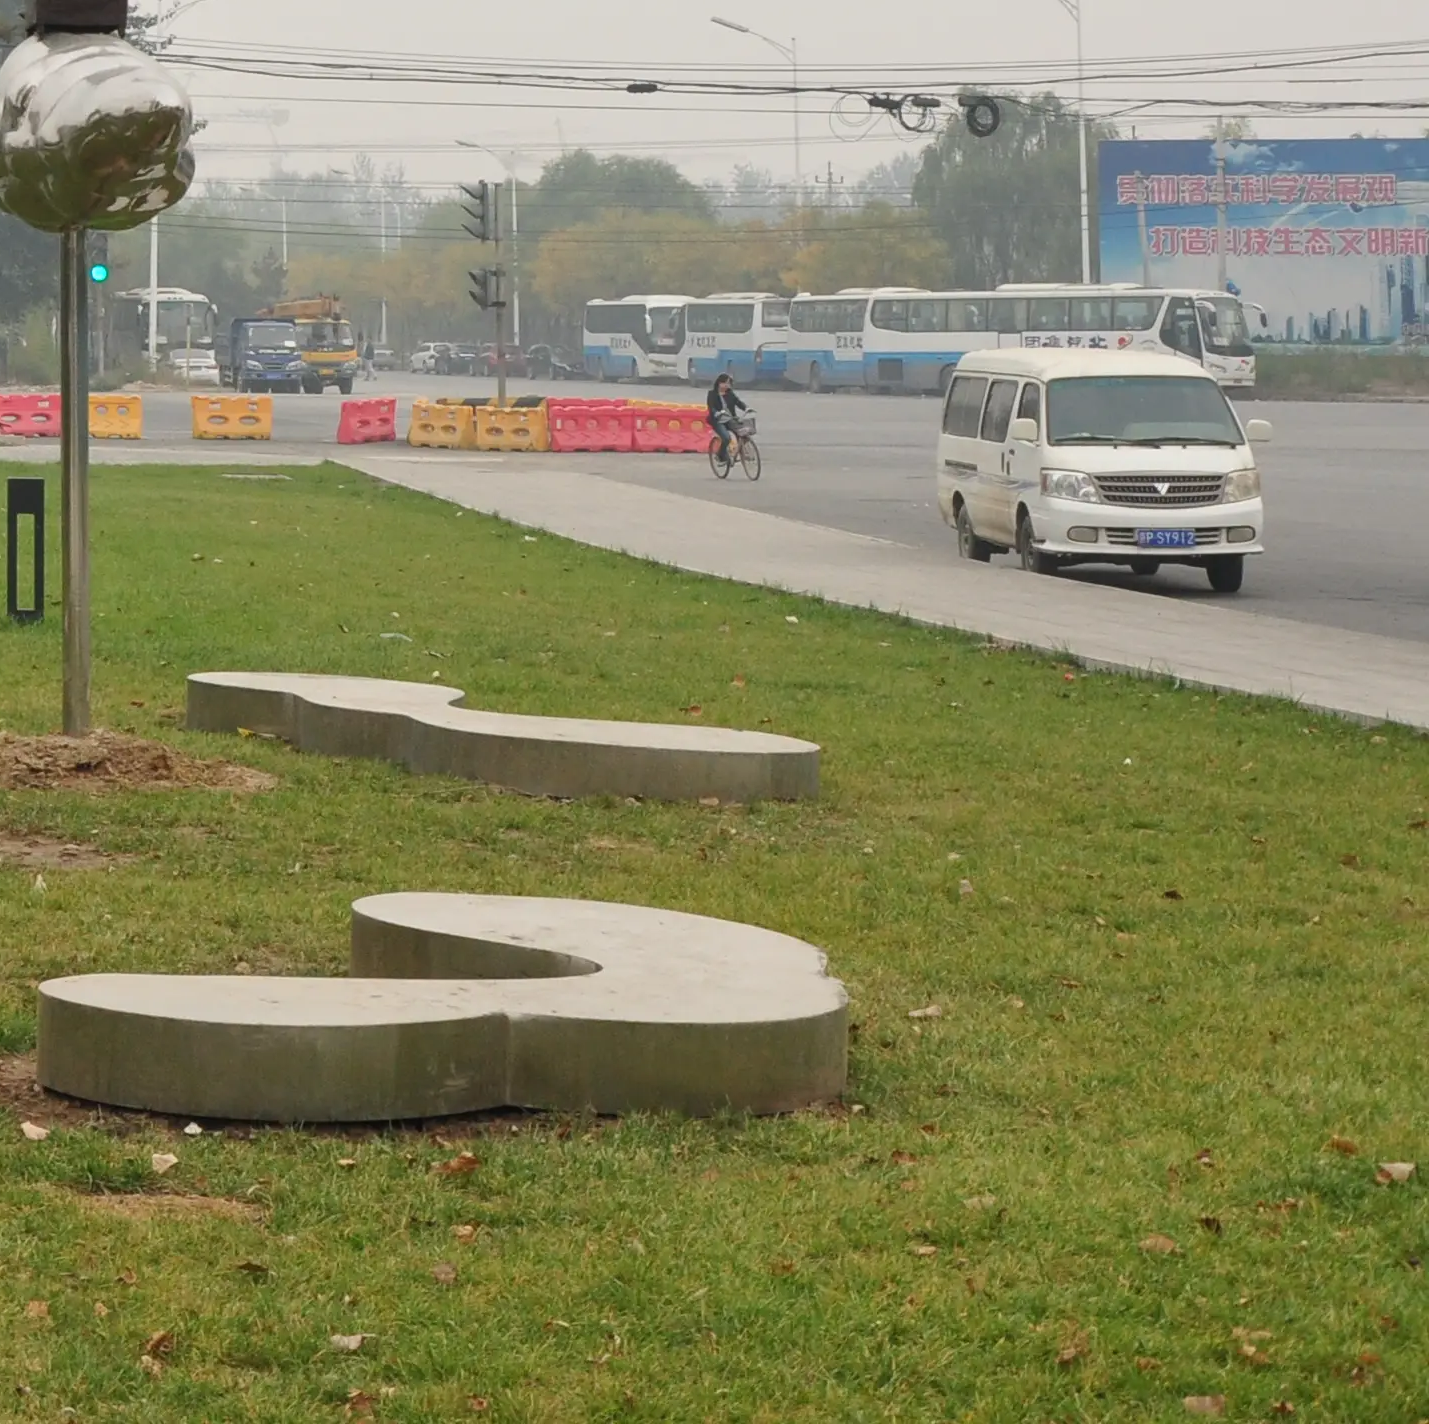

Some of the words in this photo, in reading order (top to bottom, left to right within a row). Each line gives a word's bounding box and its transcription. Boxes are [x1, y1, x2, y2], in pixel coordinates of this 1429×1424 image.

[1117, 174, 1396, 205] 贯彻落实科学发展观
[1149, 227, 1429, 257] 打造科技生态文明新
